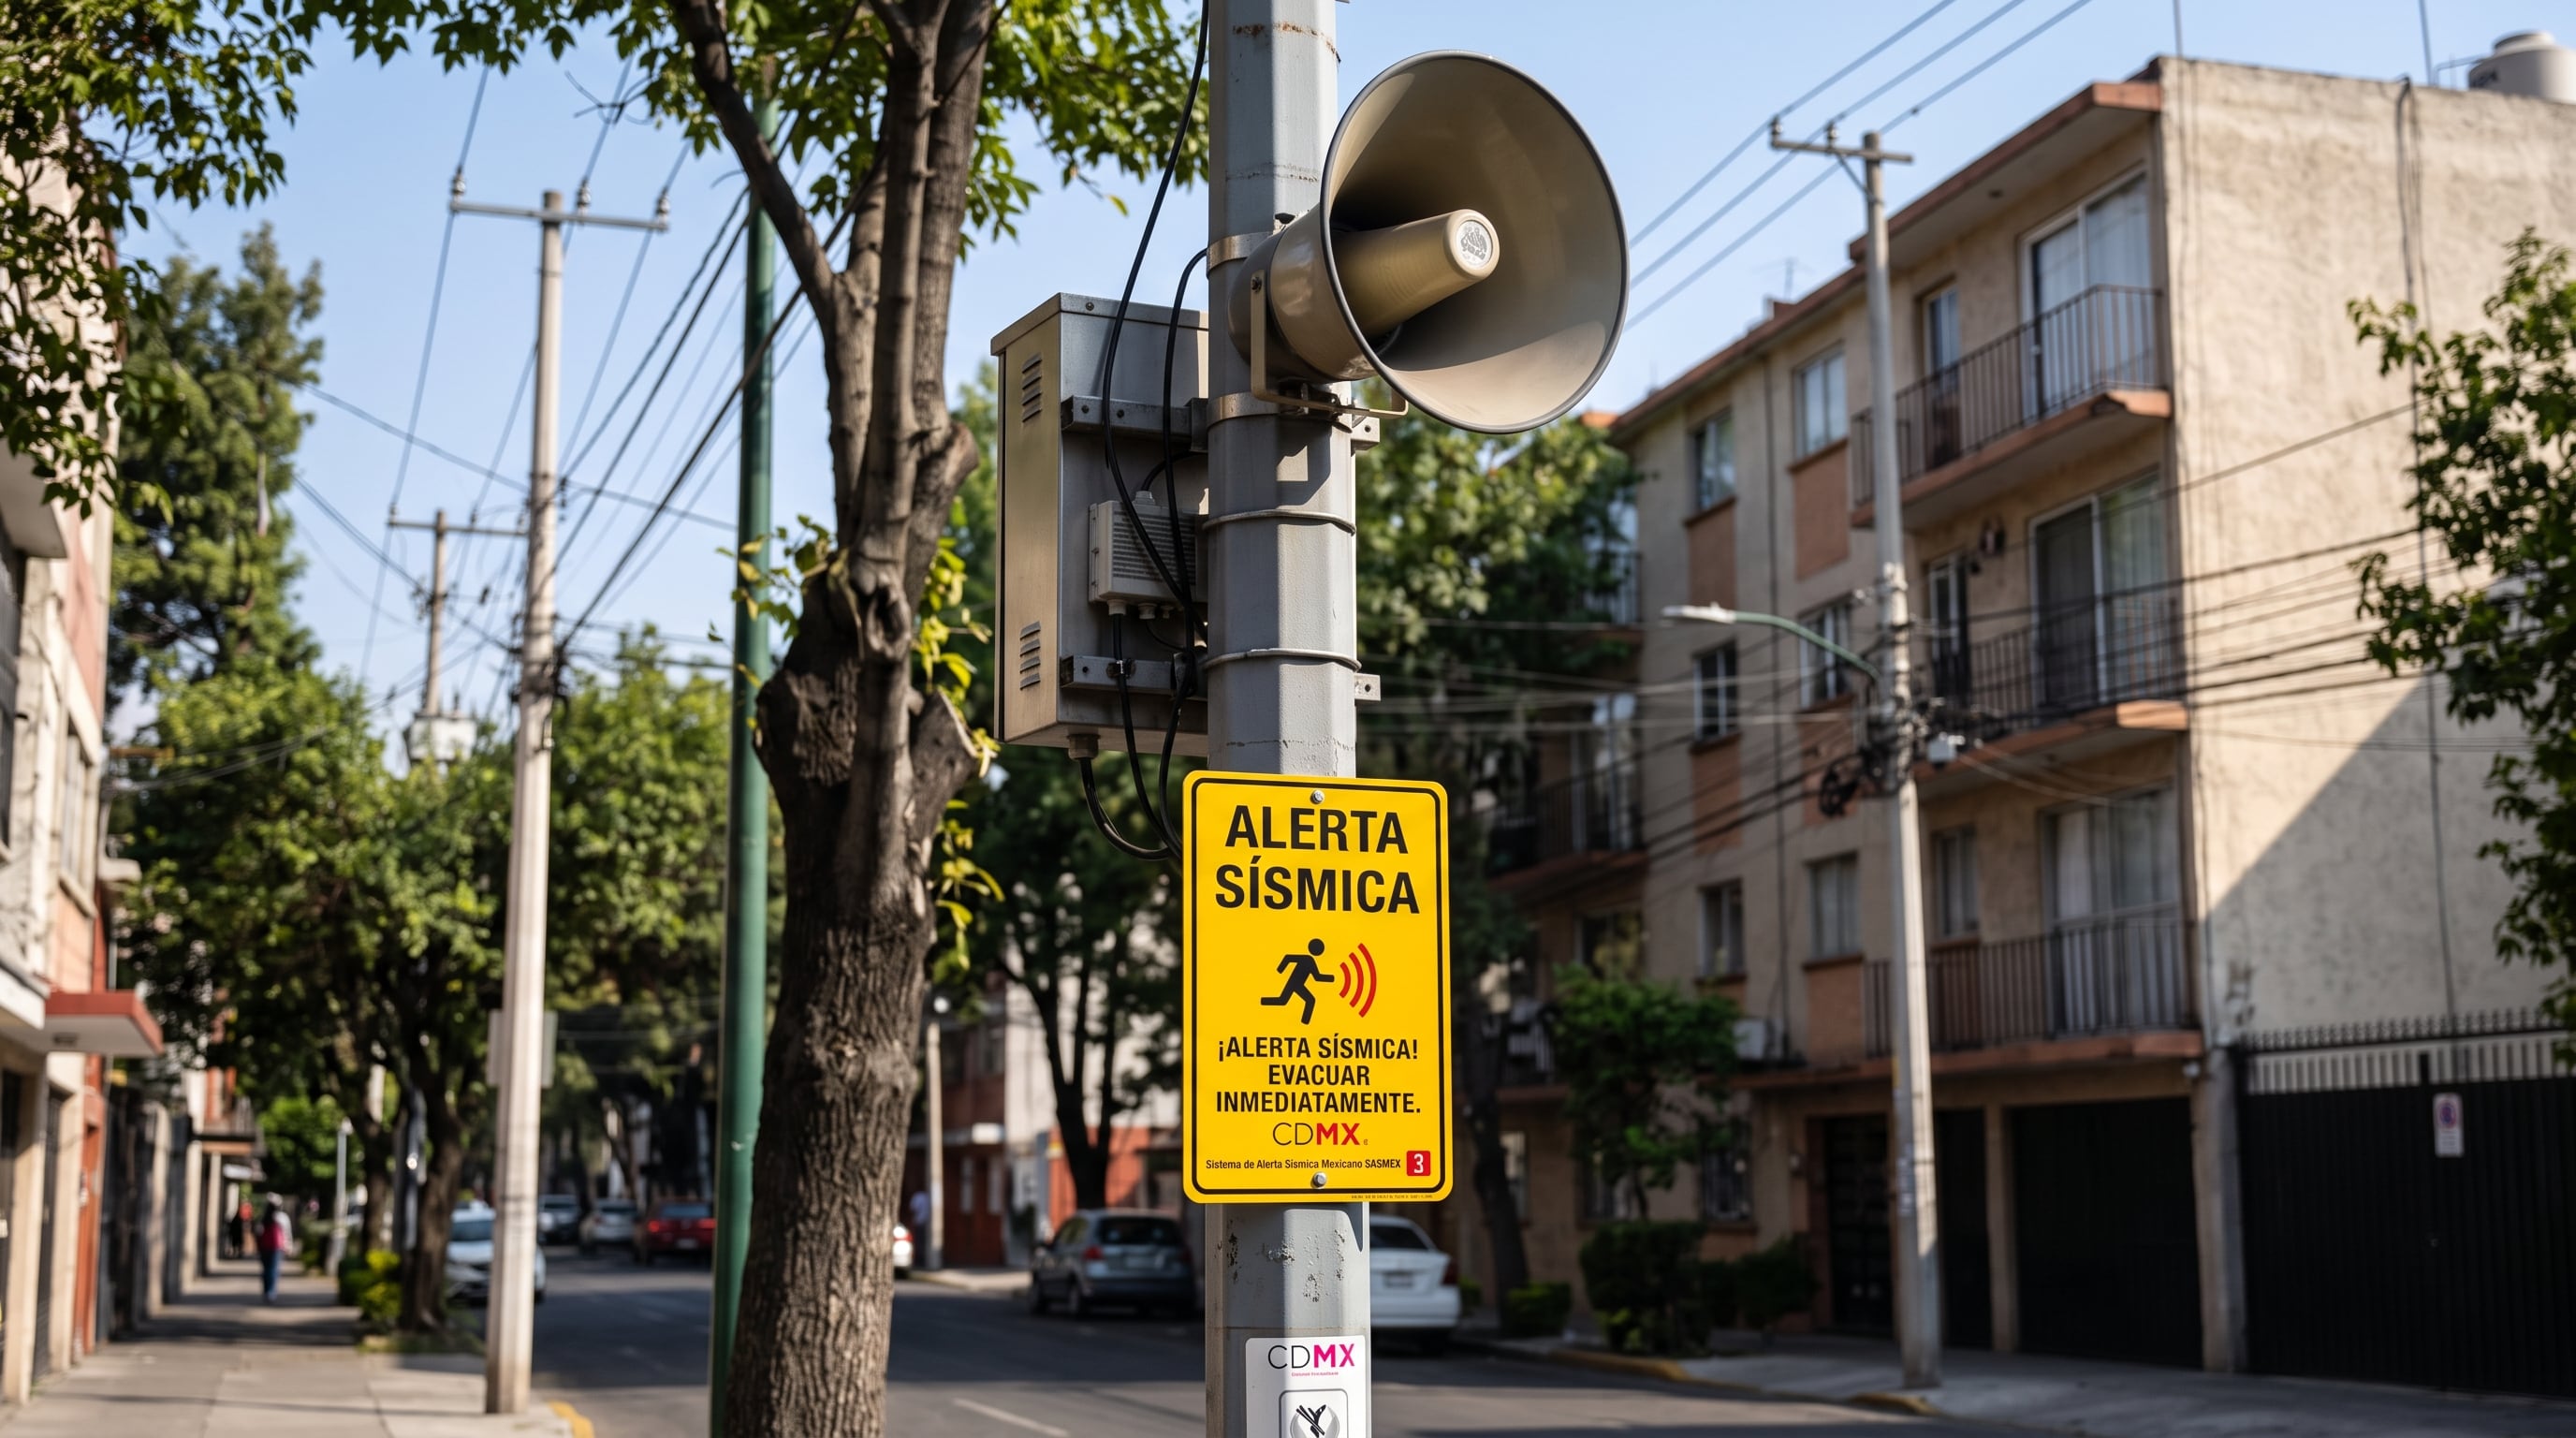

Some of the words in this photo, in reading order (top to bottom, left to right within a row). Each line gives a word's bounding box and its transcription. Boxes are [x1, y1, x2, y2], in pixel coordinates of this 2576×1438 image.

[1225, 805, 1409, 854] ALERTA
[1215, 855, 1420, 914] SÍSMICA
[1218, 1036, 1311, 1062] ¡ALERTA
[1318, 1033, 1418, 1060] SÍSMICA!
[1268, 1064, 1370, 1086] EVACUAR
[1216, 1091, 1421, 1114] INMEDIATAMENTE.
[1272, 1122, 1360, 1146] CDMX
[1206, 1159, 1241, 1169] Sistema
[1243, 1159, 1255, 1169] de
[1256, 1159, 1282, 1169] Alerta
[1321, 1159, 1363, 1168] Mexicano
[1365, 1159, 1401, 1168] SASMEX
[1413, 1152, 1424, 1174] 3
[1267, 1343, 1355, 1370] CDMX
